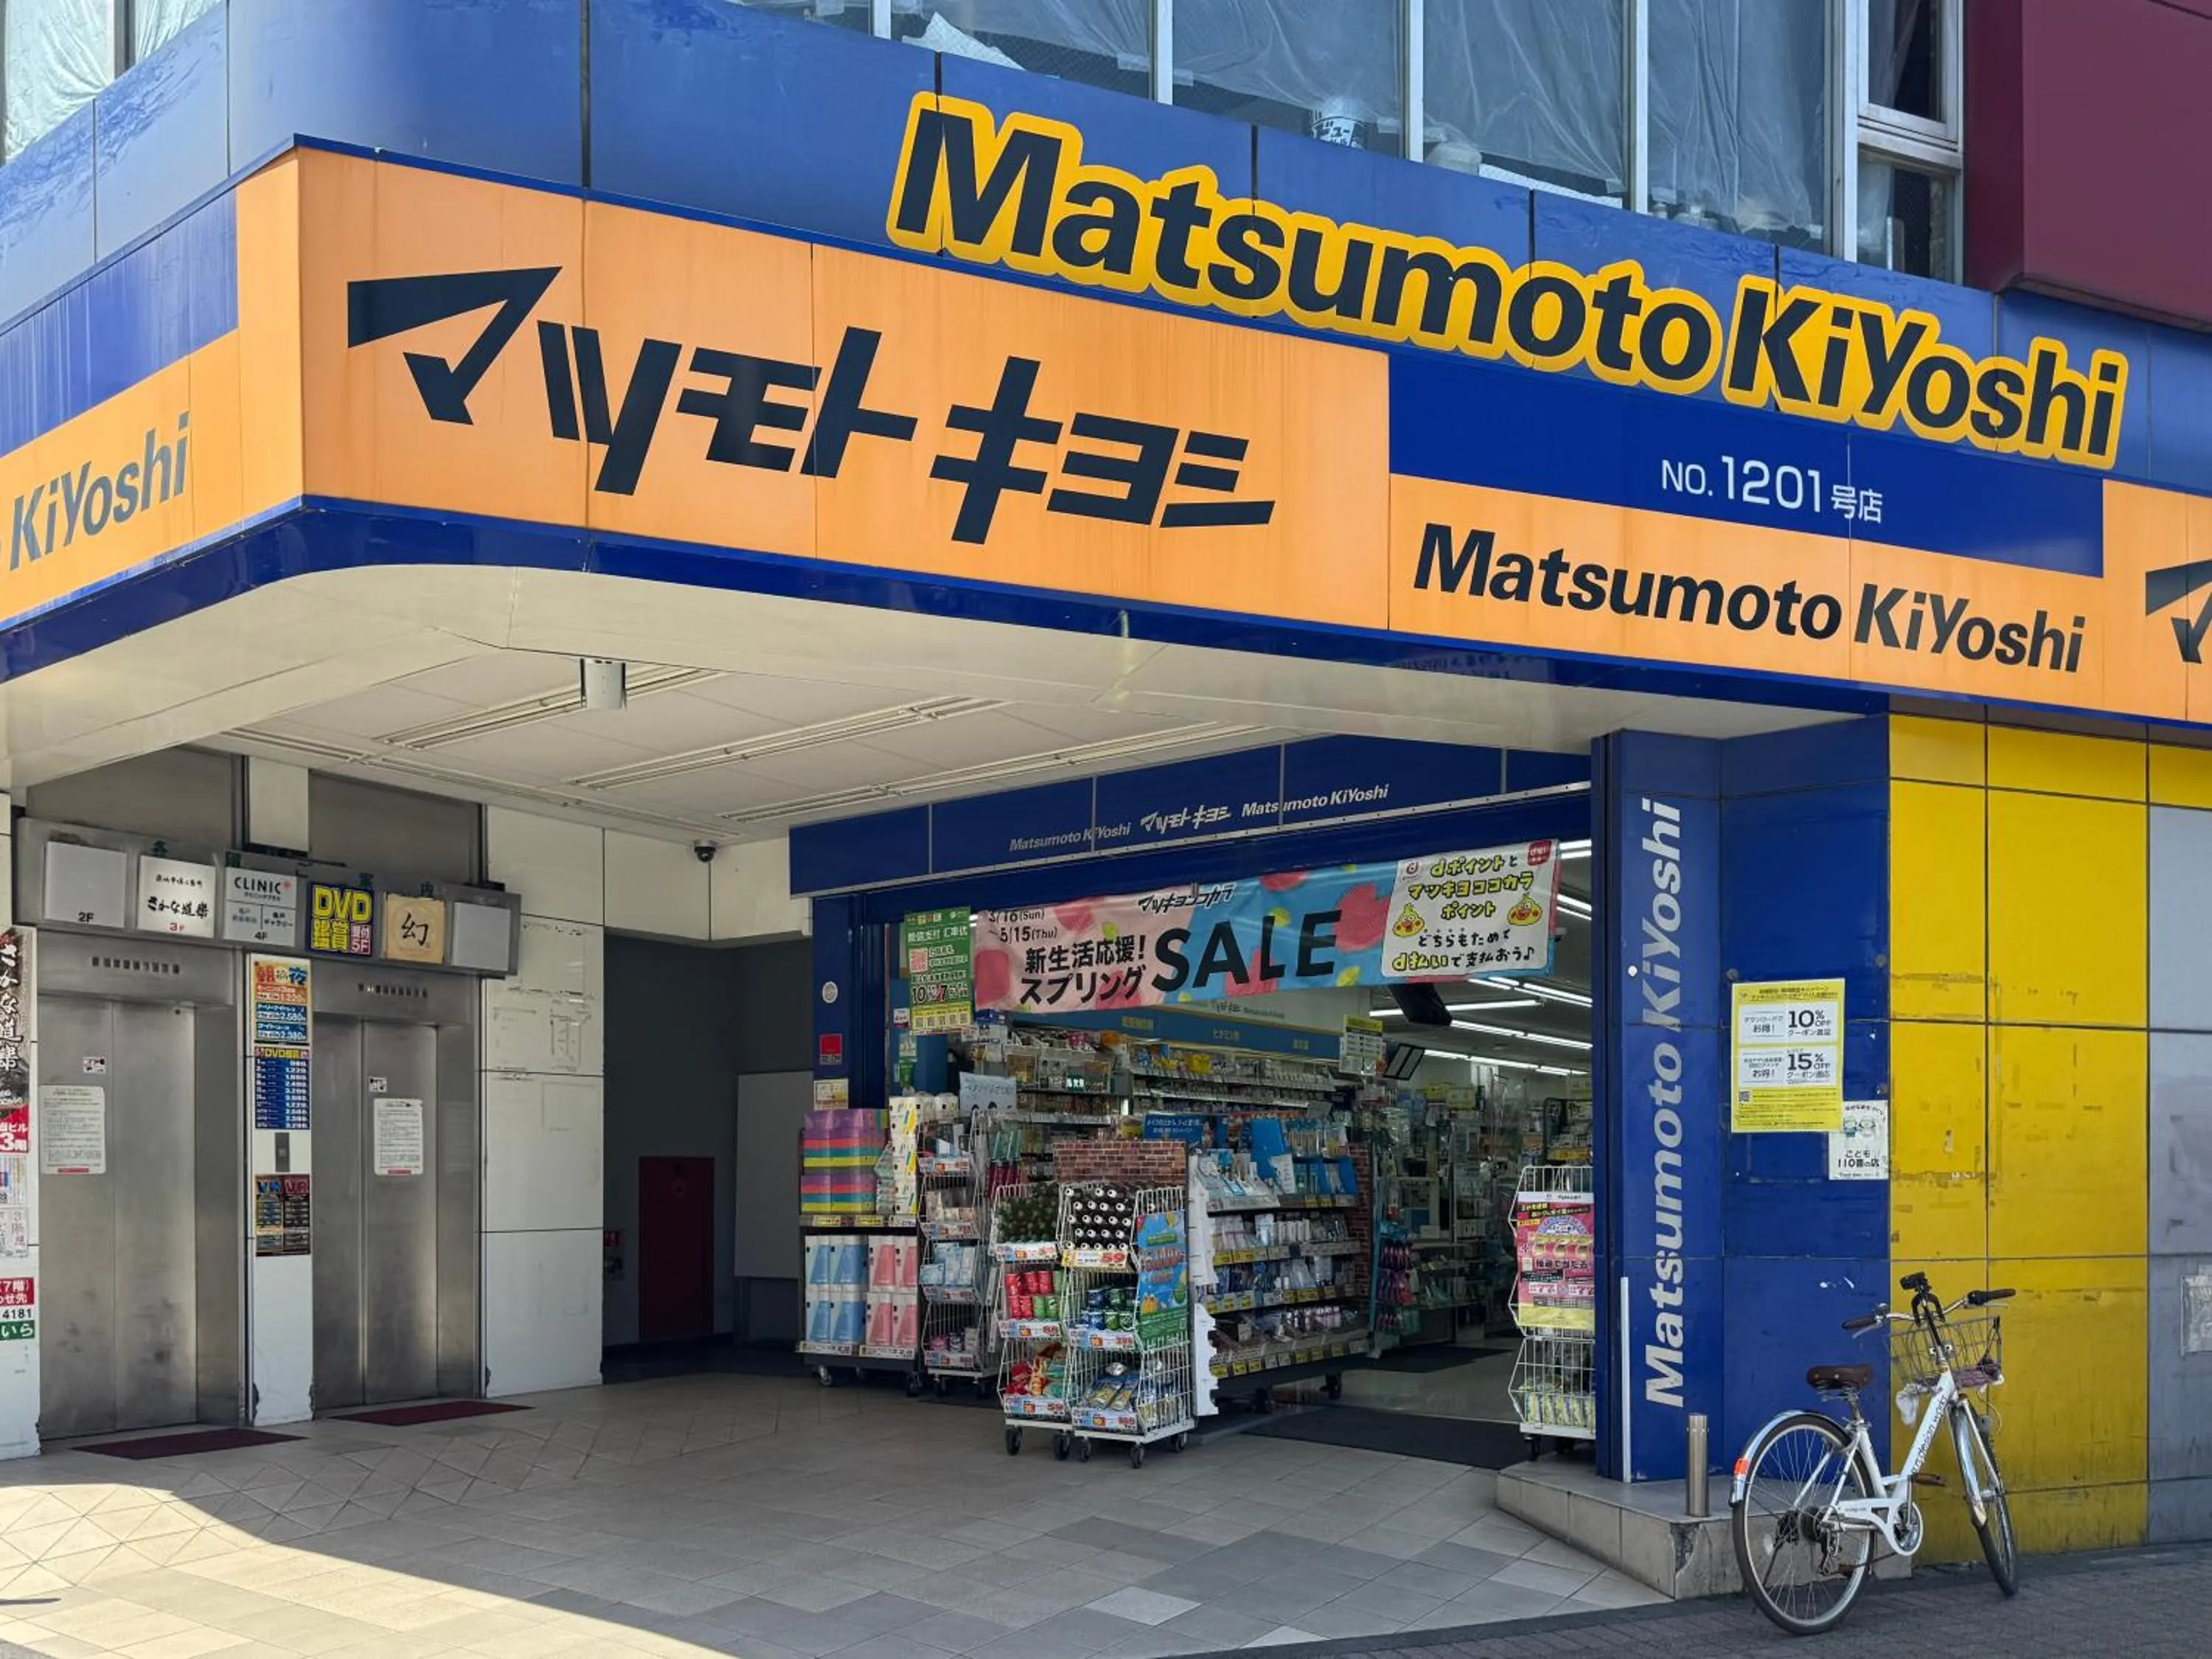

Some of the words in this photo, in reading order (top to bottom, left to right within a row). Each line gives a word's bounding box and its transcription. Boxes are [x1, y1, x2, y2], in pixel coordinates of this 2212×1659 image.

[895, 108, 1712, 382] Matsumoto
[1728, 288, 2120, 456] KiYoshi
[348, 265, 1276, 545] マツモトキヨシ
[10, 411, 189, 571] KiYoshi
[1413, 522, 1842, 640] Matsumoto
[1853, 582, 2087, 673] KiYoshi
[1329, 783, 1389, 805] KiYoshi
[1009, 830, 1081, 851] Matsumoto
[1082, 821, 1132, 841] KYoshi
[1139, 805, 1231, 835] マツモトキヨシ
[313, 885, 372, 922] DVD
[1408, 870, 1534, 901] マツキヨココカラ
[77, 911, 94, 922] 2F
[1440, 900, 1497, 921] ポイント
[1641, 796, 1681, 1033] KiYoshi
[254, 931, 268, 942] 4F
[400, 912, 429, 947] 幻
[1151, 909, 1343, 992] SALE
[1019, 963, 1147, 1006] スプリング
[1645, 1042, 1683, 1408] Matsumoto
